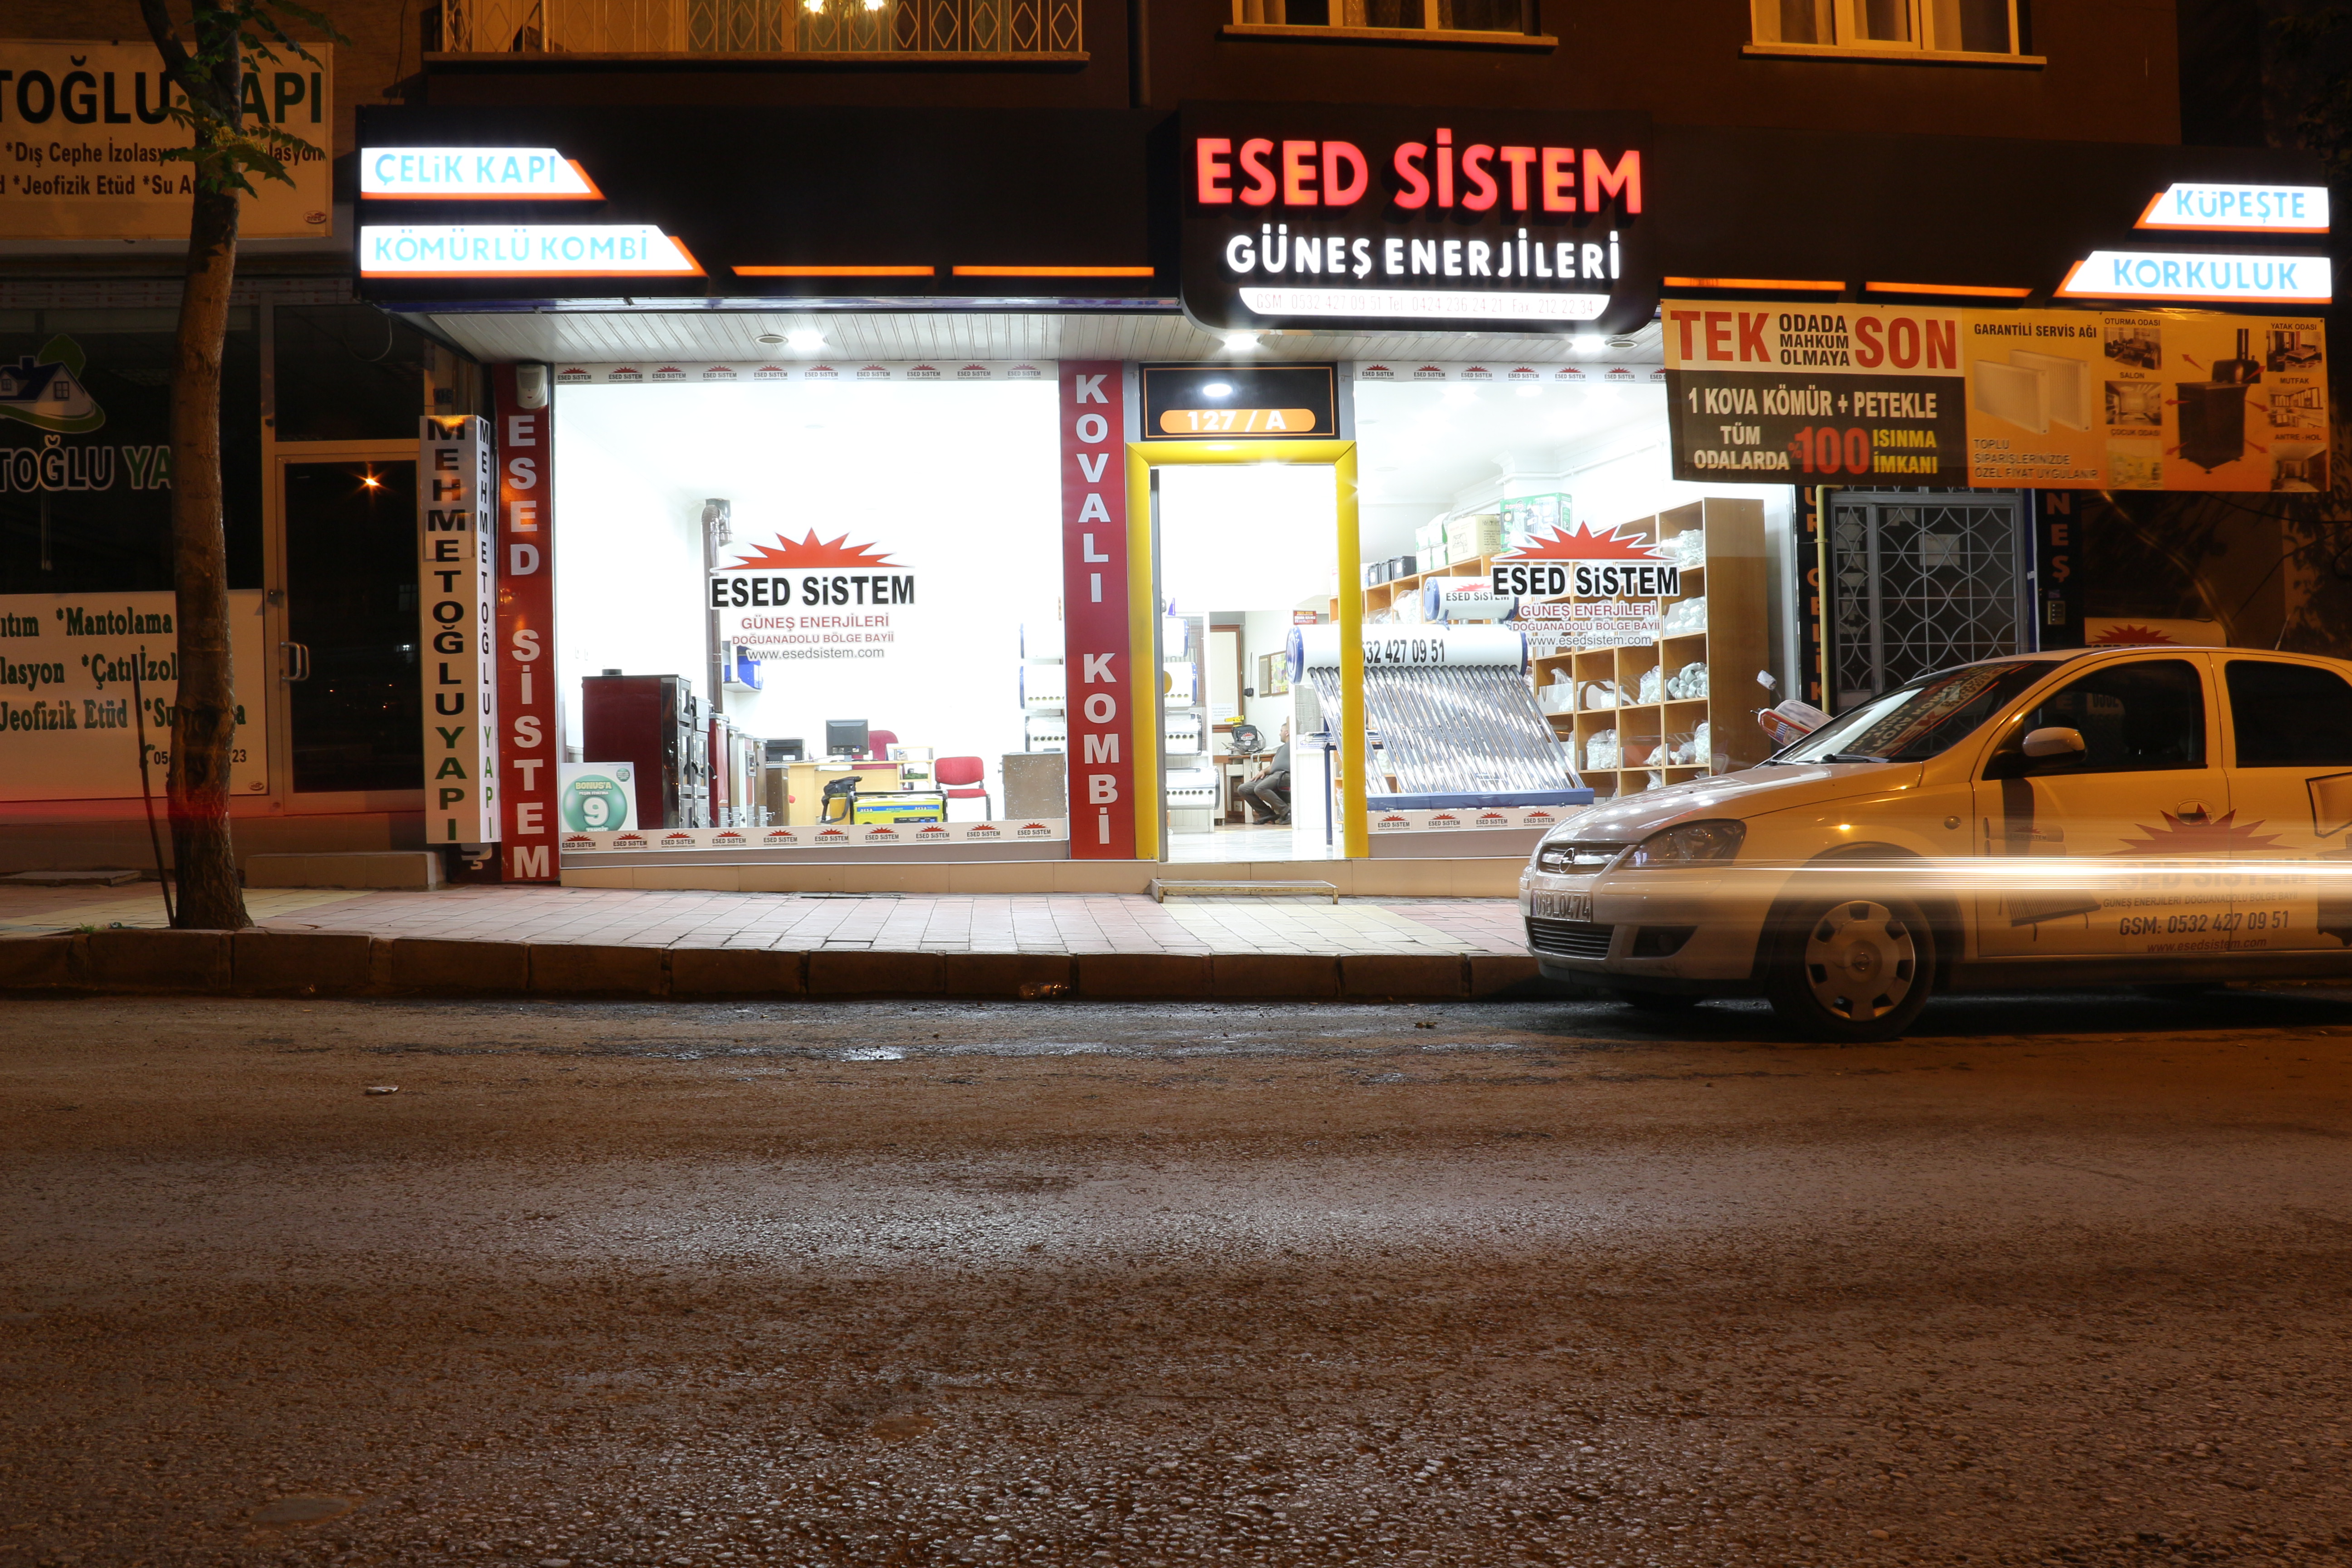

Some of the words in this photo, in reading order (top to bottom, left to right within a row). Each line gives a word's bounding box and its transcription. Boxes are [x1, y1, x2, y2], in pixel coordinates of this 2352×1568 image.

[240, 72, 322, 124] API
[50, 142, 102, 166] Cephe
[477, 155, 555, 183] KAPI
[1197, 137, 1368, 207] ESED
[1394, 127, 1641, 214] SİSTEM
[97, 175, 135, 195] Etüd
[2176, 190, 2305, 223] KÜPEŞTE
[376, 228, 530, 261] KÖMÜRLÜ
[541, 230, 647, 260] KOMBİ
[1226, 224, 1372, 279] GÜNEŞ
[1385, 228, 1620, 279] ENERJİLERİ
[2114, 259, 2298, 290] KORKULUK
[1292, 294, 1319, 309] 0532
[1326, 295, 1345, 309] 427
[1351, 296, 1365, 309] 09
[1371, 296, 1381, 309] 51
[1413, 297, 1441, 311] 0424
[1447, 297, 1467, 311] 236
[1473, 298, 1486, 312] 24
[1492, 298, 1502, 312] 21
[1539, 299, 1556, 313] 212
[1562, 300, 1574, 314] 22
[1581, 300, 1593, 314] 34
[1779, 314, 1847, 333] ODADA
[1975, 322, 2032, 336] GARANTİLİ
[2036, 323, 2075, 337] SERVİS
[2079, 325, 2097, 338] AĞI
[1671, 310, 1771, 363] TEK
[1780, 333, 1849, 349] MAHKUM
[1855, 316, 1957, 369] SON
[1781, 349, 1850, 367] OLMAYA
[1689, 387, 1698, 414] 1
[1705, 388, 1759, 415] KOVA
[1764, 384, 1833, 416] KÖMÜR
[1854, 392, 1937, 418] PETEKLE
[1187, 411, 1237, 431] 127
[1265, 411, 1287, 430] A
[1720, 422, 1760, 445] TÜM
[1872, 429, 1936, 447] ISINMA
[1974, 439, 2009, 449] TOPLU
[1694, 450, 1790, 470] ODALARDA
[1873, 452, 1938, 474] İMKANI
[508, 415, 540, 576] ESED
[1075, 374, 1111, 603] KOVALI
[712, 577, 790, 607] ESED
[1493, 567, 1565, 595] ESED
[1446, 593, 1470, 601] ESED
[741, 615, 795, 631] GÜNEŞ
[800, 612, 889, 628] ENERJİLERİ
[1521, 603, 1570, 619] GÜNEŞ
[1575, 601, 1656, 615] ENERJİLERİ
[1513, 619, 1592, 631] DOĞUANADOLU
[1596, 621, 1631, 630] BÖLGE
[732, 632, 819, 645] DOĞUANADOLU
[823, 632, 862, 642] BÖLGE
[1528, 636, 1651, 645] www.esedsistem.com
[748, 647, 884, 659] www.esedsistem.com
[1386, 639, 1407, 663] 427
[1412, 639, 1426, 662] 09
[1431, 639, 1445, 662] 51
[83, 699, 127, 728] Etüd
[1083, 653, 1119, 844] KOMBİ
[435, 727, 467, 841] YAPI
[483, 726, 493, 839] YAPI
[583, 797, 608, 825] 9
[2103, 898, 2132, 909] GÜNEŞ
[2134, 896, 2181, 907] ENERJİLERİ
[2185, 893, 2248, 904] DOĞUANADOLU
[2250, 892, 2277, 901] BÖLGE
[2119, 917, 2161, 936] GSM:
[2167, 915, 2208, 934] 0532
[2213, 913, 2243, 931] 427
[2248, 912, 2267, 930] 09
[2272, 911, 2289, 929] 51
[2148, 939, 2267, 953] www.esedsistem.com
